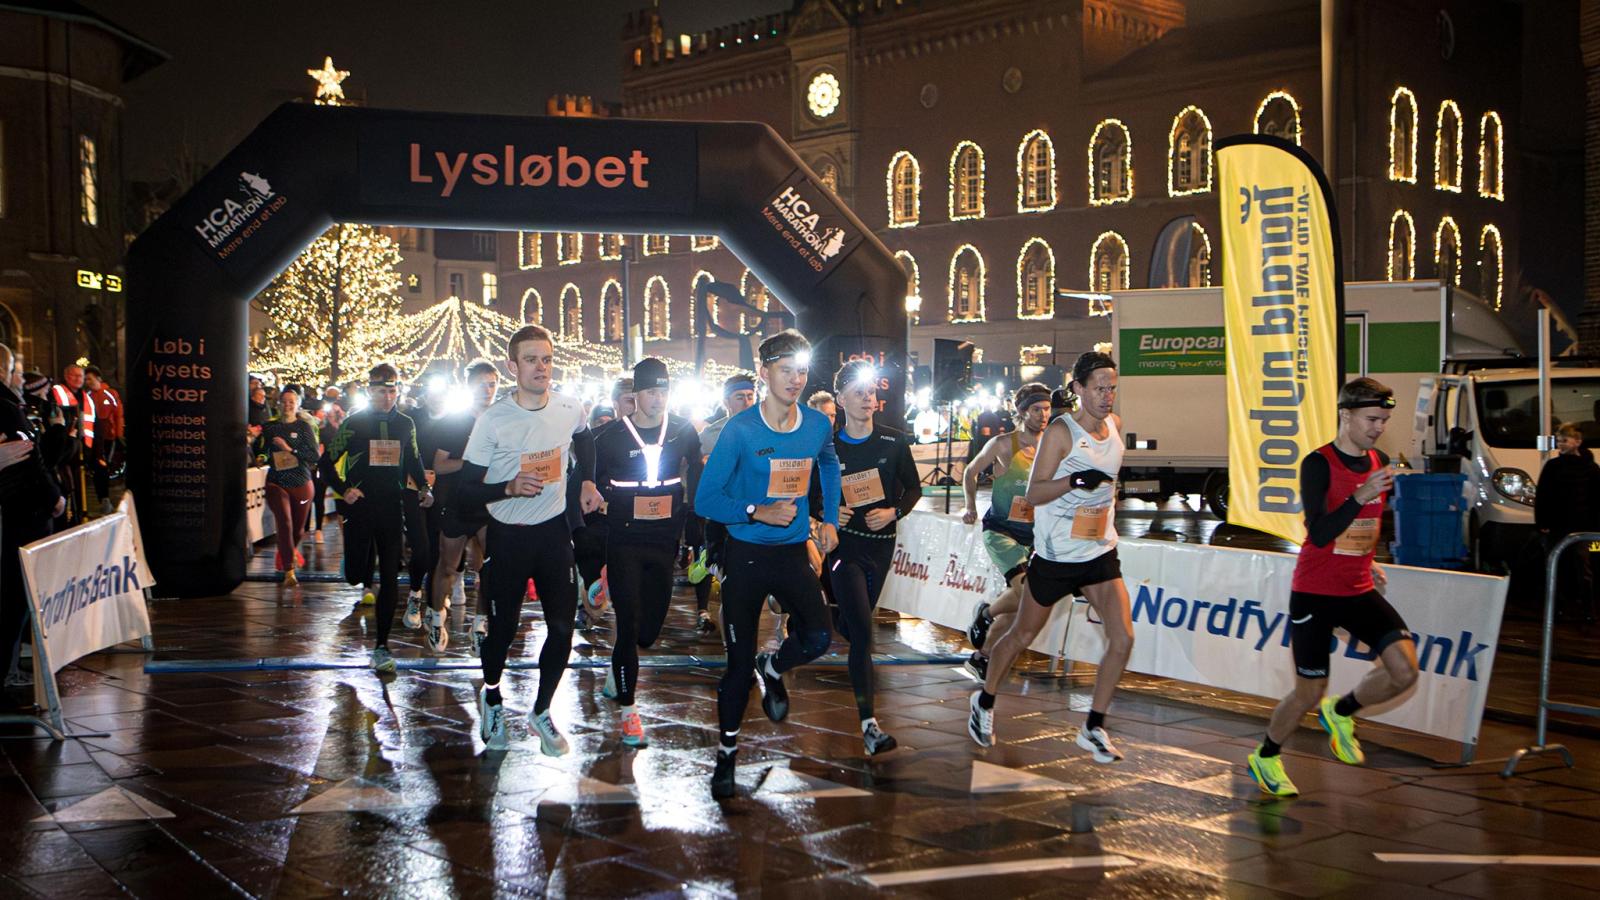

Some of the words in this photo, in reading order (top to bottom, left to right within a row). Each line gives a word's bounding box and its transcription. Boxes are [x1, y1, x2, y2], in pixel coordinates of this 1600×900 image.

[409, 143, 650, 198] Lysløbet
[195, 198, 243, 239] HCA
[207, 196, 264, 248] MARATHON
[771, 198, 824, 252] MARATHON
[780, 186, 820, 231] HCA
[153, 337, 194, 356] Løb
[199, 337, 206, 356] i
[147, 359, 213, 382] lysets
[150, 386, 209, 403] skær
[1132, 585, 1489, 682] Nordfynk
